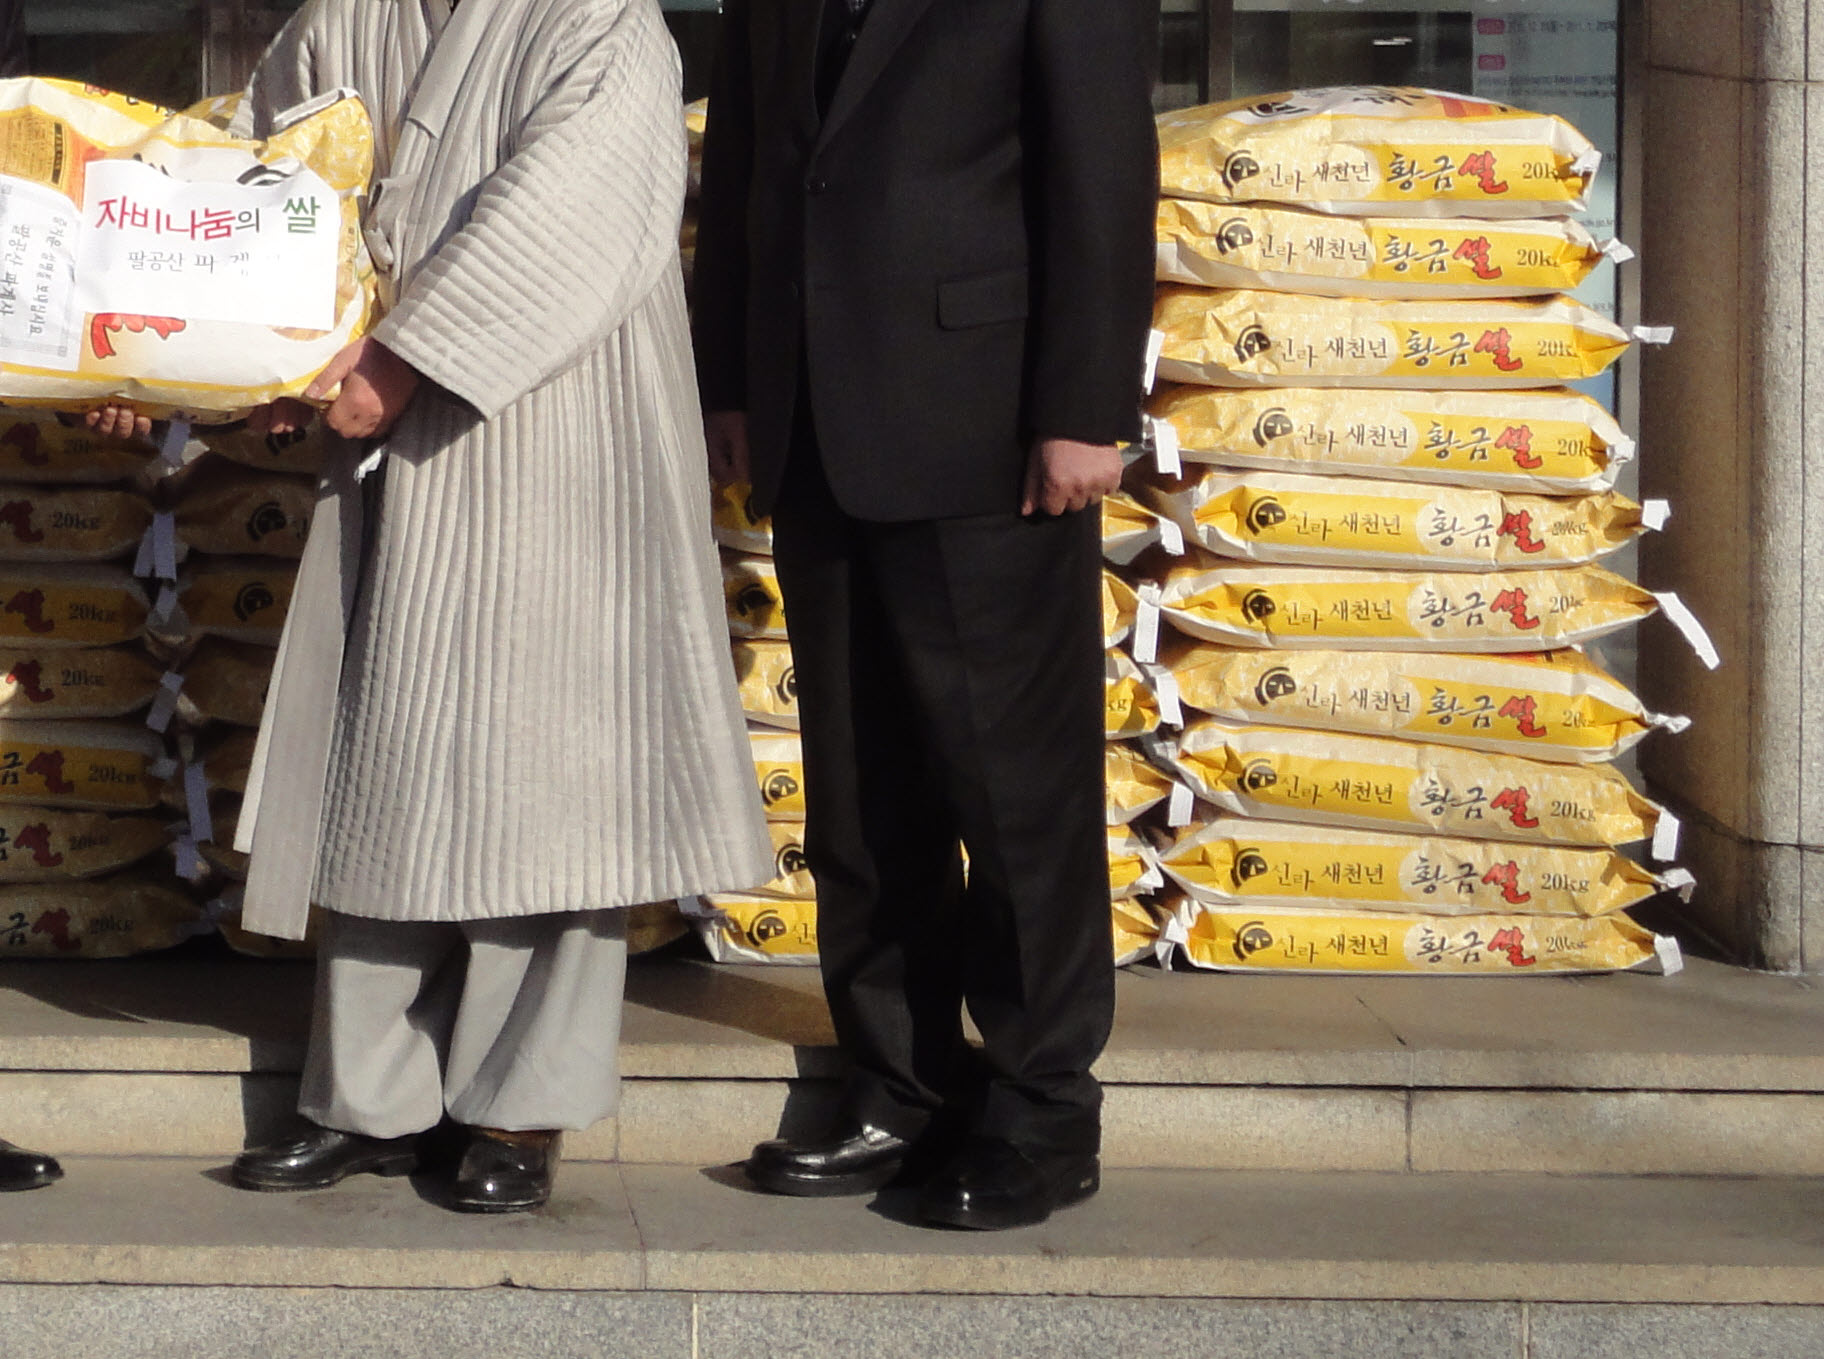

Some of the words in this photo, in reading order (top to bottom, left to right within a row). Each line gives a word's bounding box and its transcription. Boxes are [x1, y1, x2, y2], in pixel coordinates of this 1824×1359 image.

[1311, 160, 1371, 184] 새천년
[94, 195, 261, 241] 자비나눔의
[281, 195, 321, 235] 쌀
[127, 249, 184, 273] 팔공산
[1303, 236, 1369, 262] 새천년
[1324, 338, 1389, 360] 새천년
[1344, 424, 1409, 449] 새천년
[1338, 512, 1402, 537] 새천년
[1329, 598, 1394, 623] 새천년
[1348, 686, 1412, 714] 새천년
[1329, 776, 1394, 805] 새천년
[1321, 862, 1385, 886] 새천년
[1540, 872, 1590, 895] 20kg
[1325, 933, 1389, 958] 새천년
